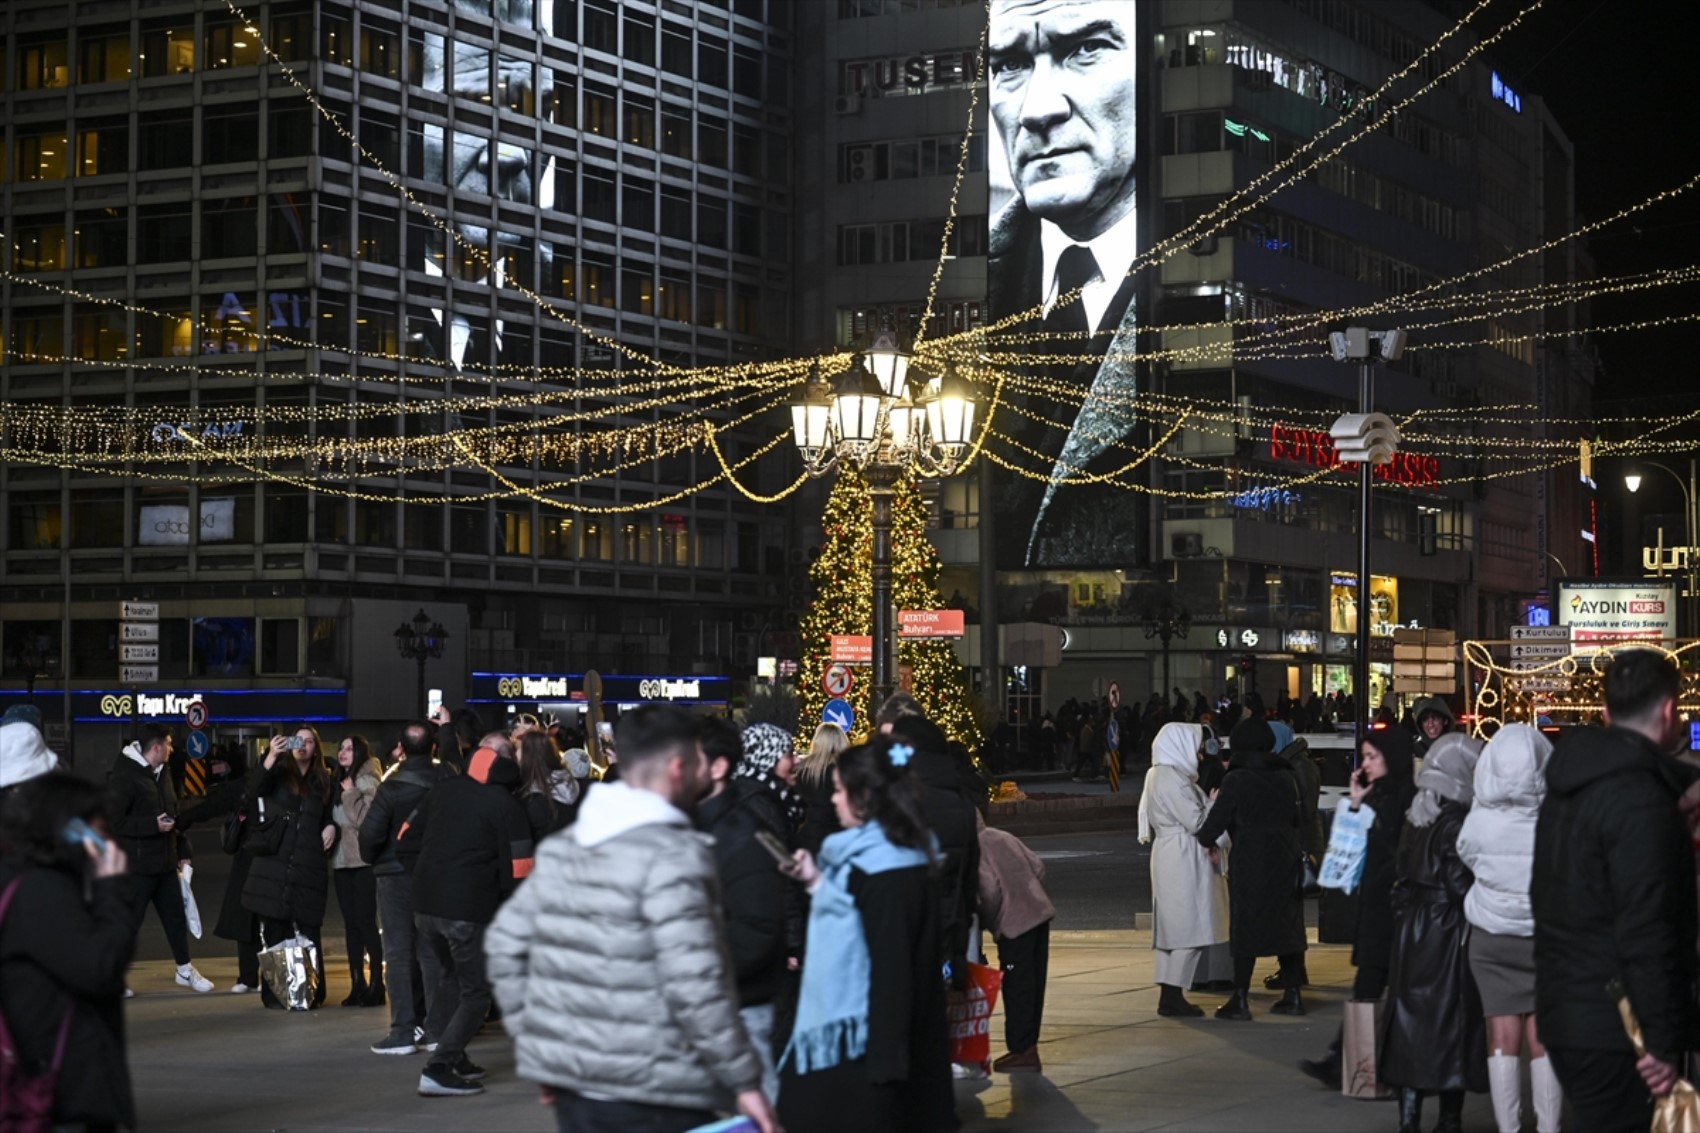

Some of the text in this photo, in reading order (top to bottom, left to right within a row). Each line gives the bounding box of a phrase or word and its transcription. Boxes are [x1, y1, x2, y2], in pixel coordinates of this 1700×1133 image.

[1579, 601, 1662, 614] AYDIN KURS
[903, 612, 940, 622] ATATÜRK
[903, 625, 933, 634] Bulvarı
[137, 693, 164, 717] Yapı
